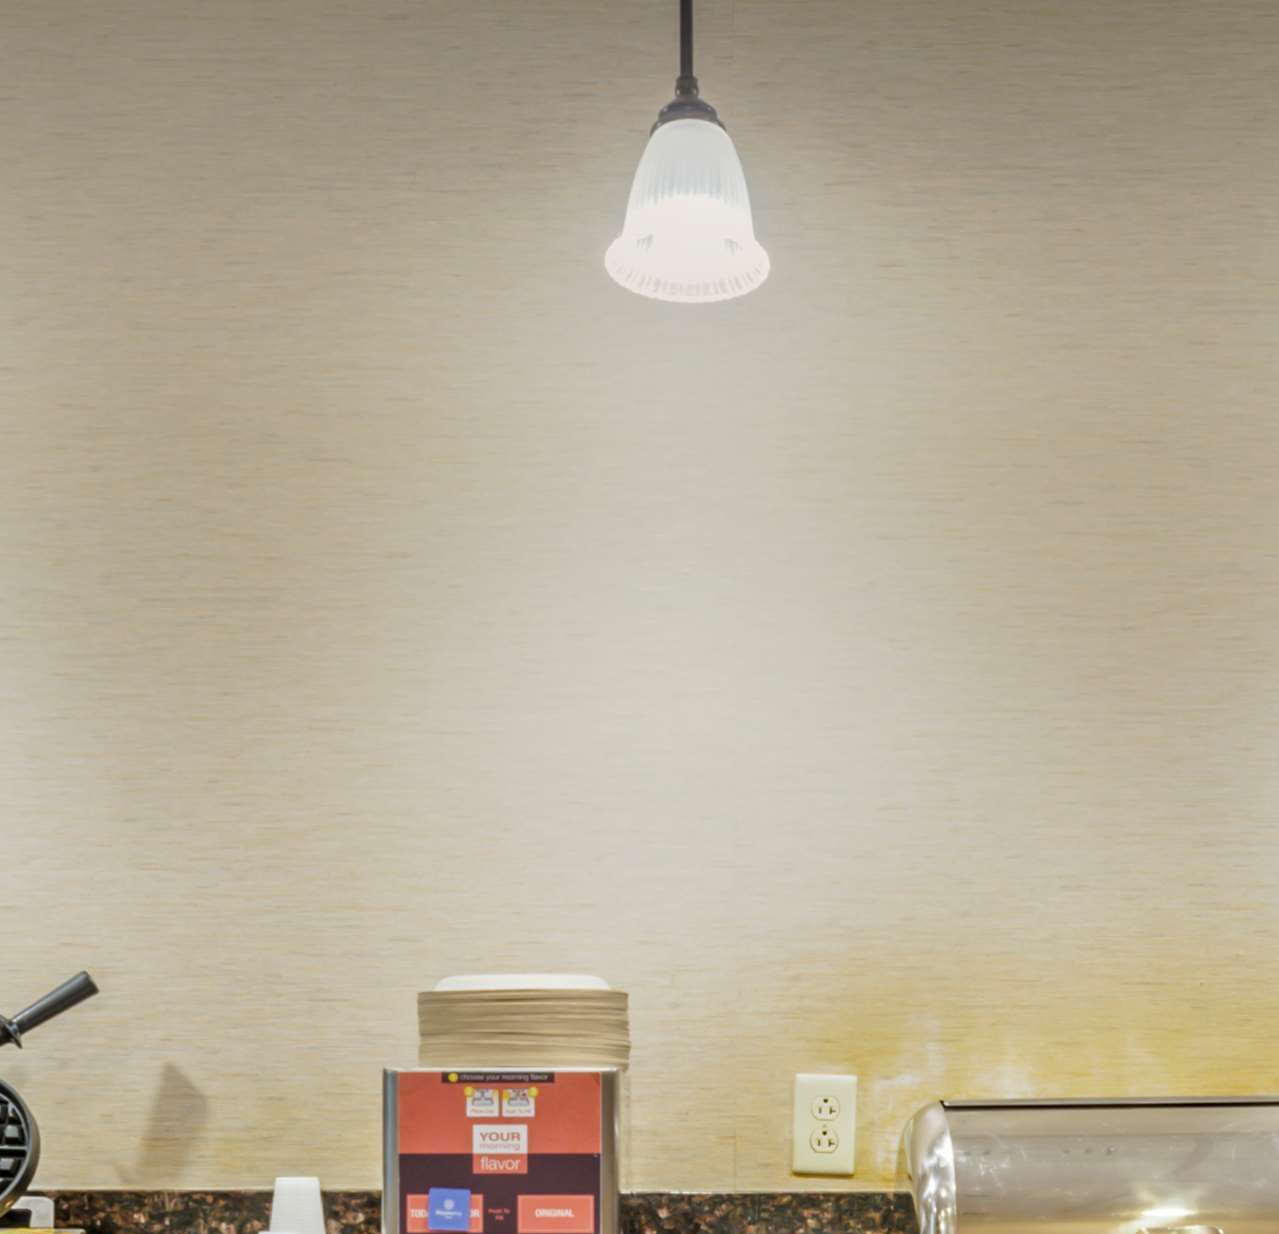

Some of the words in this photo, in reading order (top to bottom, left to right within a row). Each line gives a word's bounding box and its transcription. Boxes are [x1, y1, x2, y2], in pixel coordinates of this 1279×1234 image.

[480, 1132, 520, 1141] YOUR
[480, 1142, 520, 1151] morning
[481, 1156, 520, 1170] flavor
[535, 1208, 575, 1217] ORIGINAL
